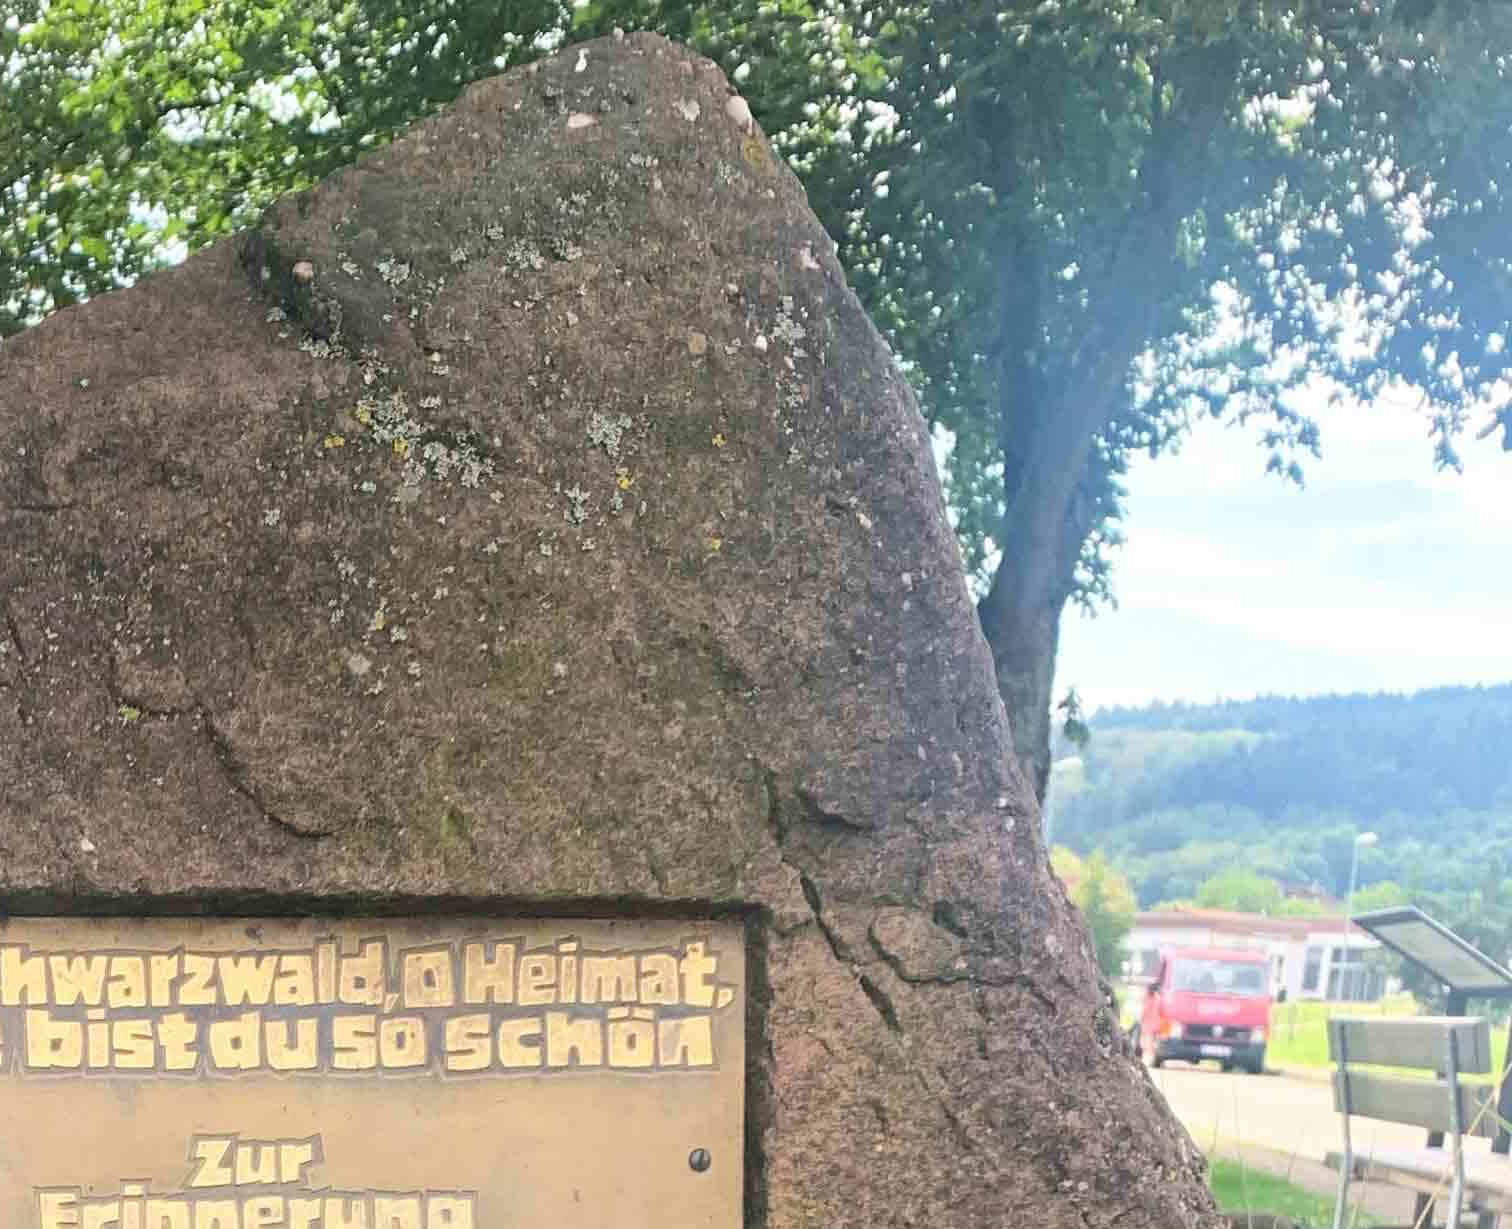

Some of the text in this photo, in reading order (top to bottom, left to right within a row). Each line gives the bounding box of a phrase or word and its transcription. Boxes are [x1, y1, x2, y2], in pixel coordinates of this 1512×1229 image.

[464, 942, 735, 1009] Heimat,
[24, 1009, 198, 1069] bist
[208, 1011, 318, 1070] du
[332, 1015, 425, 1069] so
[444, 1006, 714, 1071] schön
[190, 1138, 314, 1187] Zur
